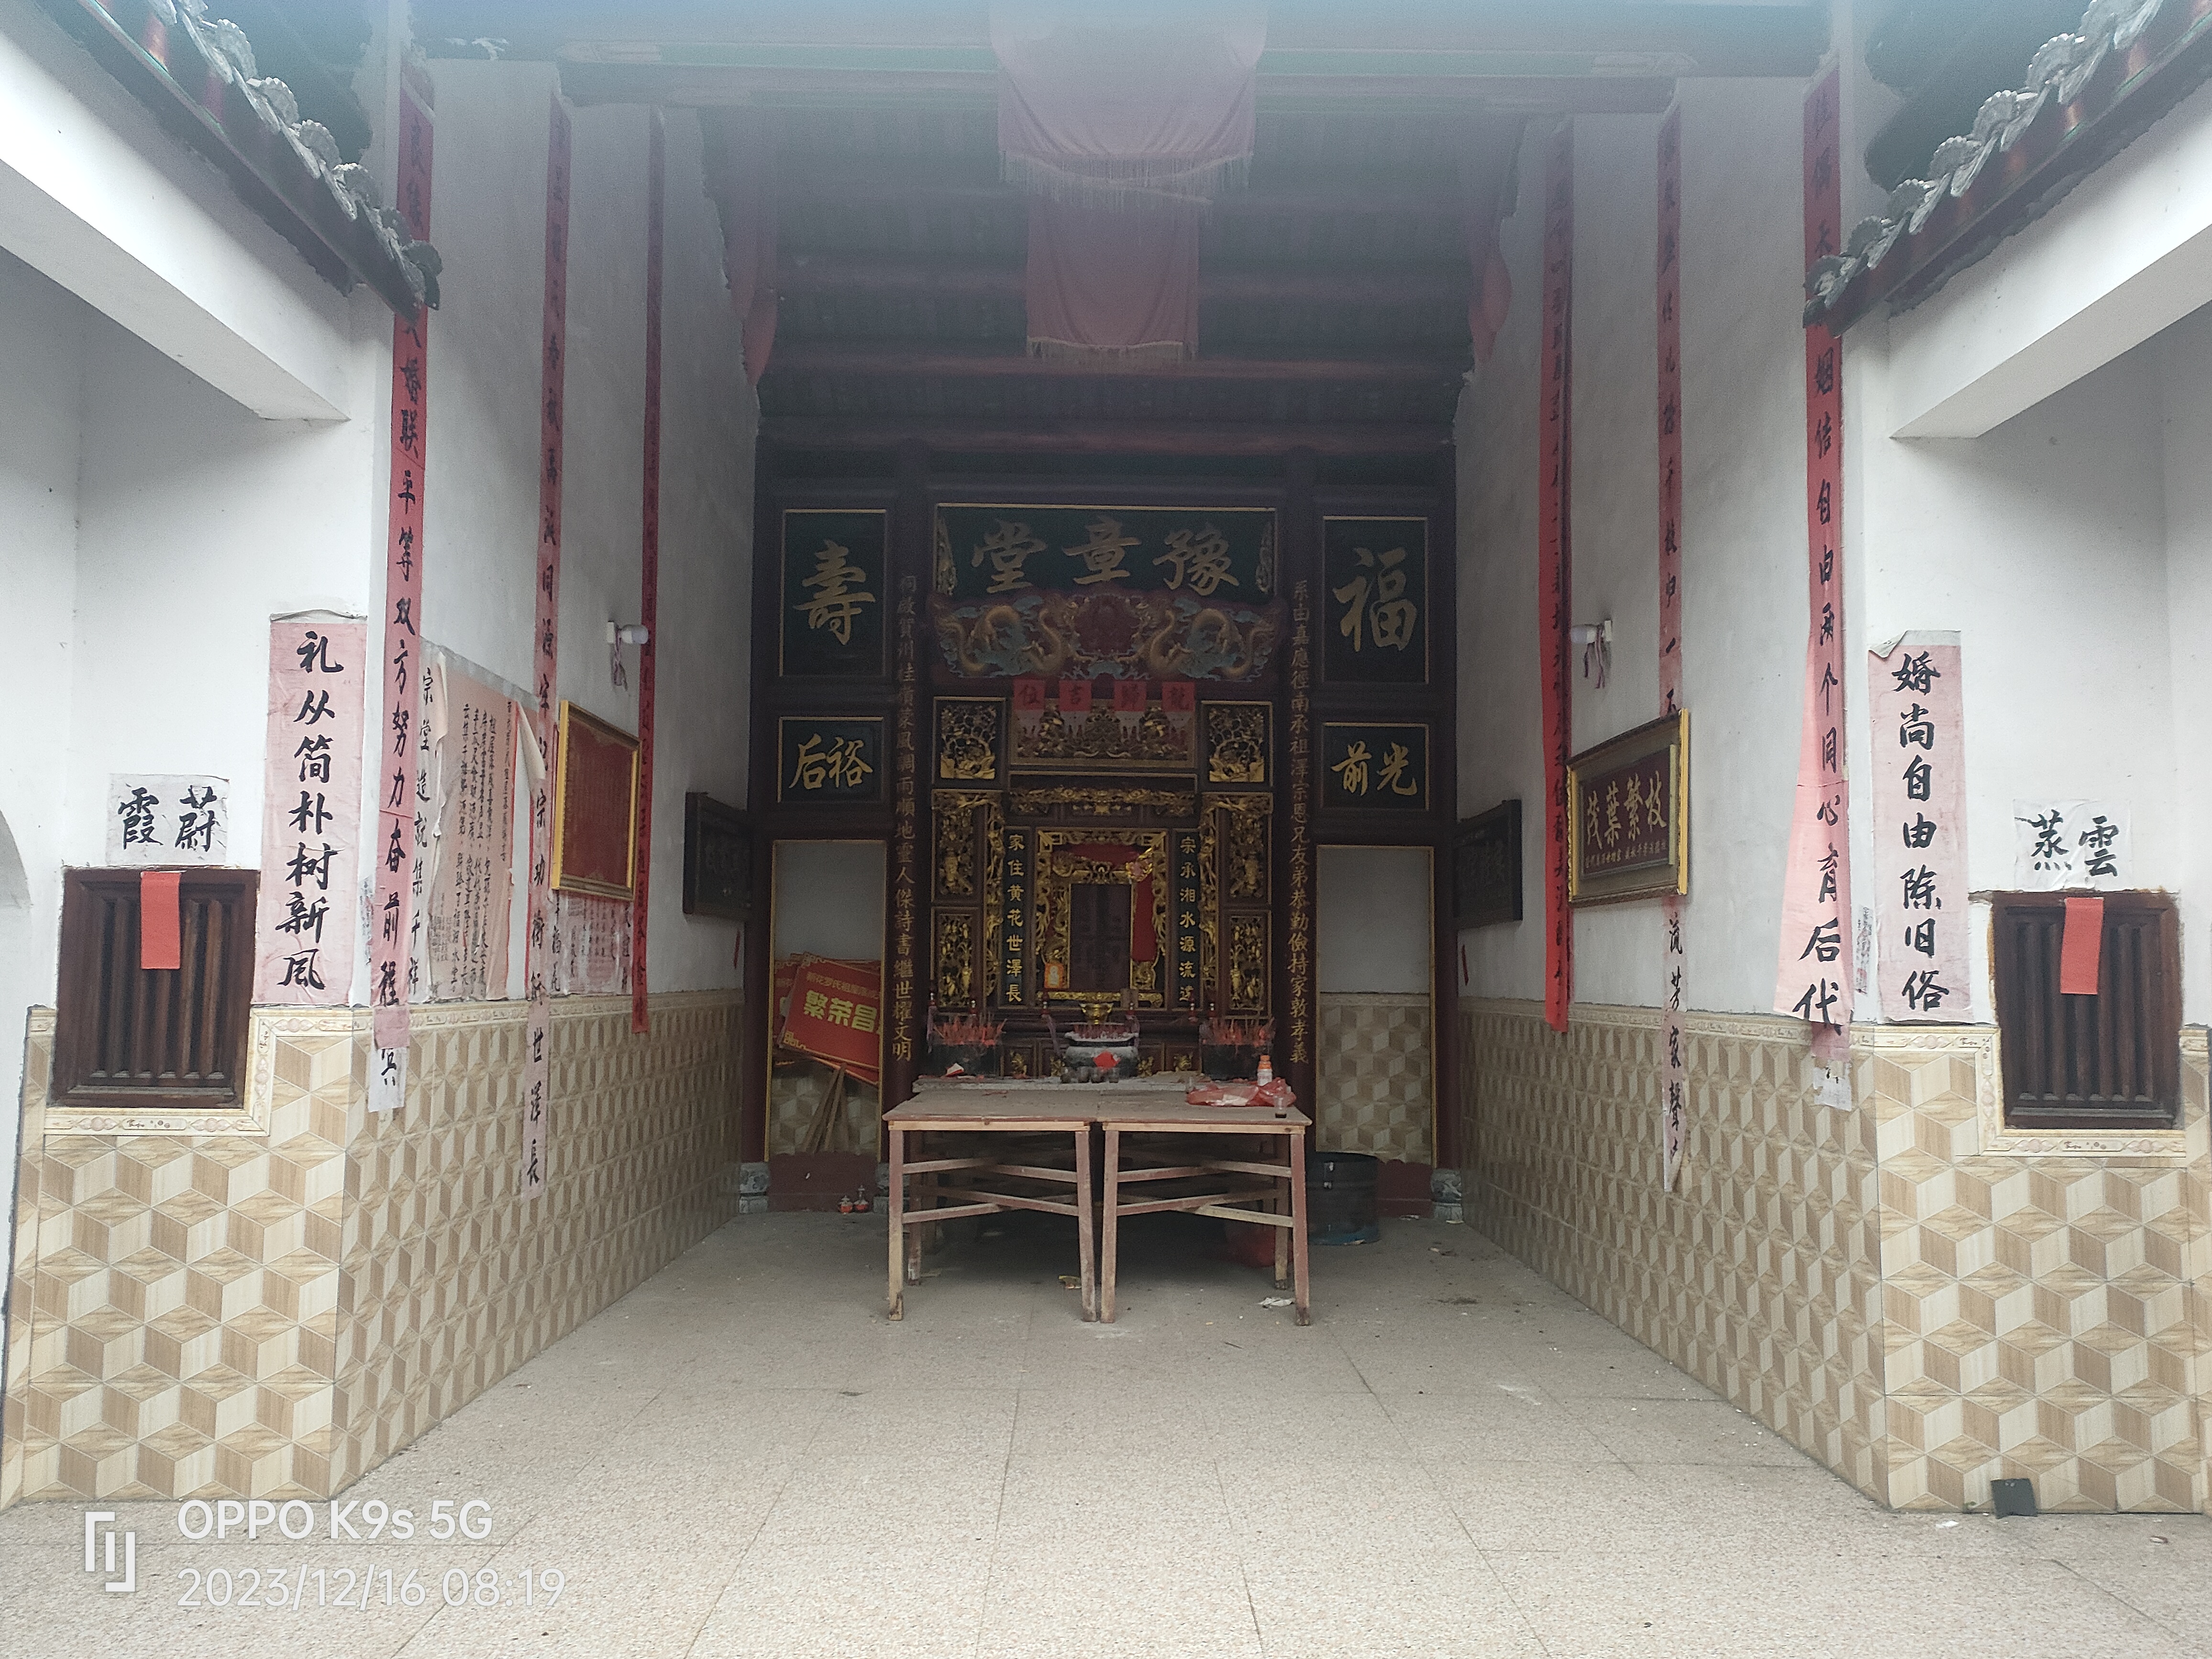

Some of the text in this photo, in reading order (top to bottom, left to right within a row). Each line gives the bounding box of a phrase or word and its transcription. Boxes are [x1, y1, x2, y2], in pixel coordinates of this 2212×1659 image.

[793, 539, 876, 646] 壽
[1333, 546, 1418, 653] 福
[1891, 651, 1949, 1013] 婚尚自由除旧俗
